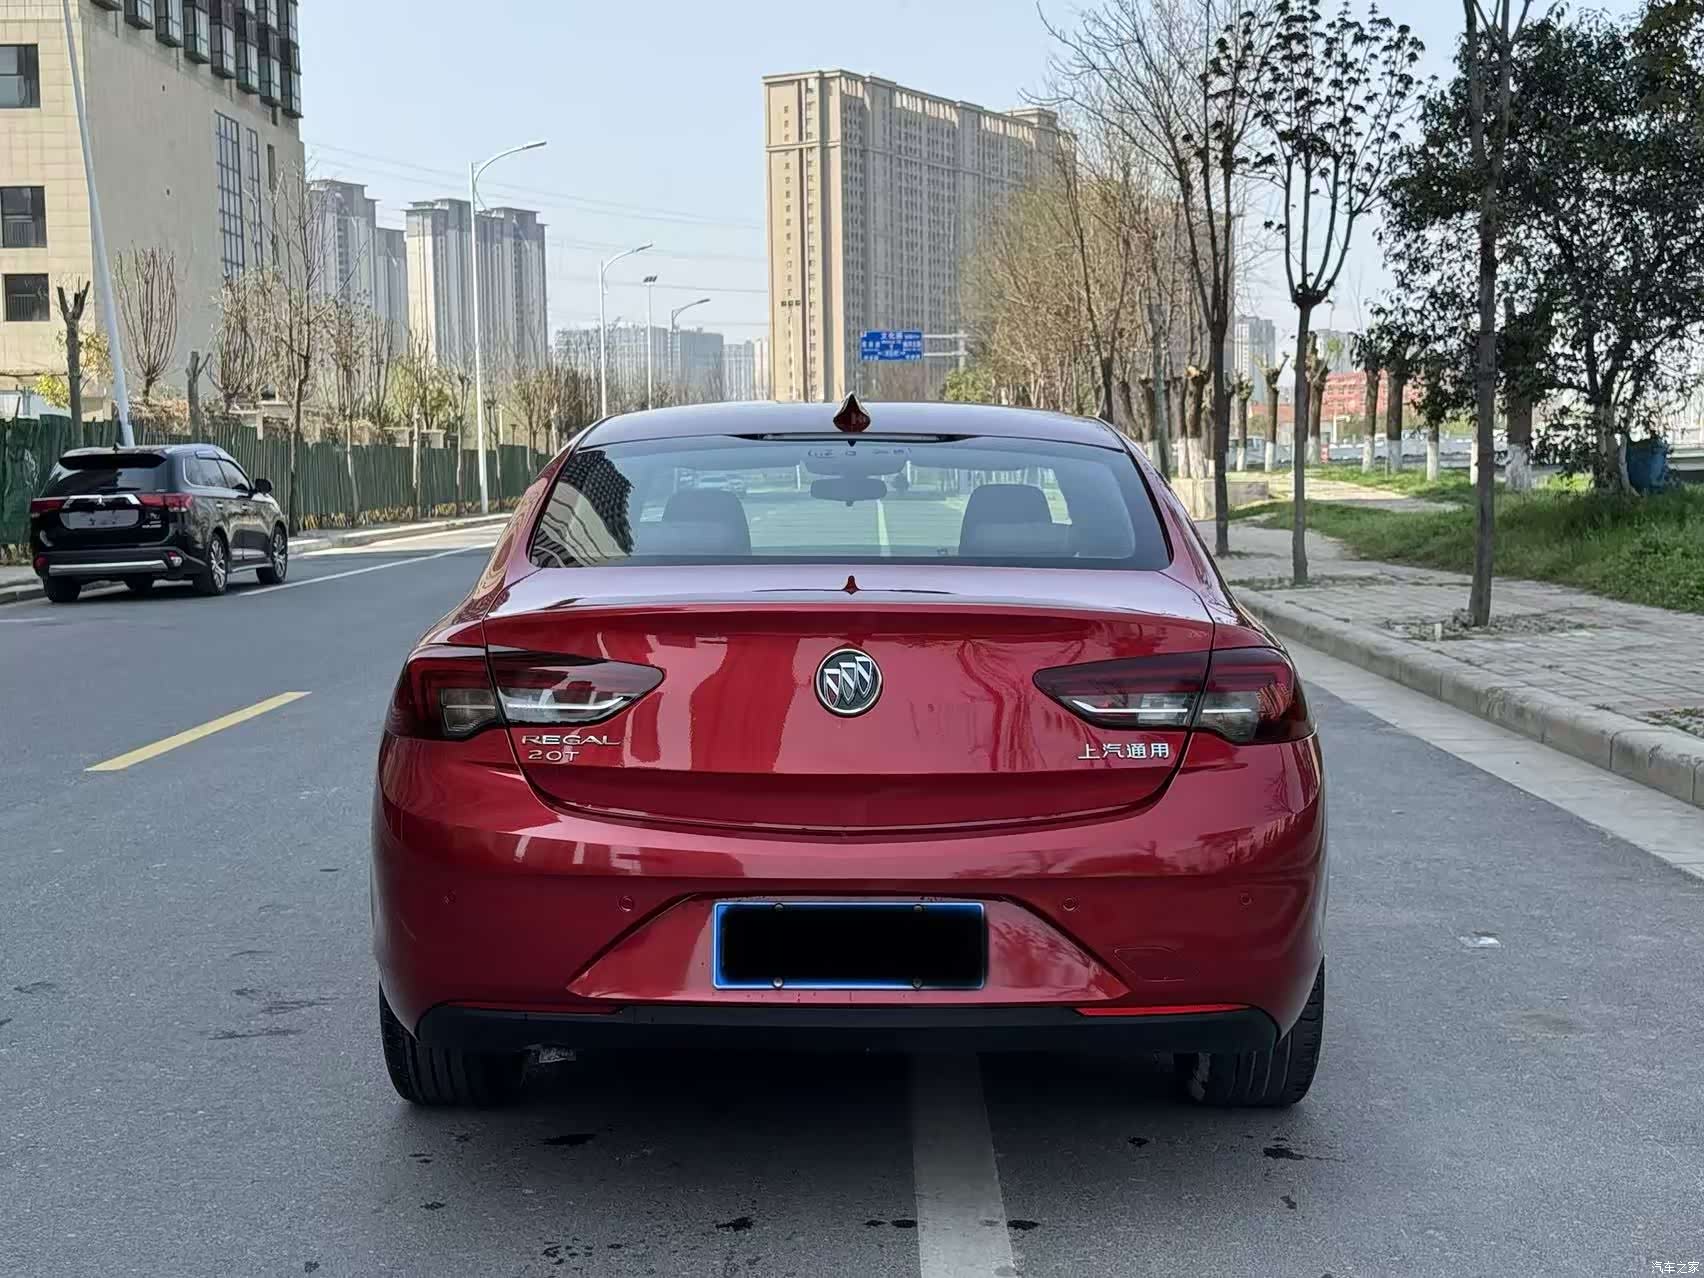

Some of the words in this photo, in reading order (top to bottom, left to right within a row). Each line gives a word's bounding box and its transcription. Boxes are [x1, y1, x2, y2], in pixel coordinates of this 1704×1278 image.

[521, 735, 621, 745] REGAL
[1078, 743, 1170, 759] 上汽通用
